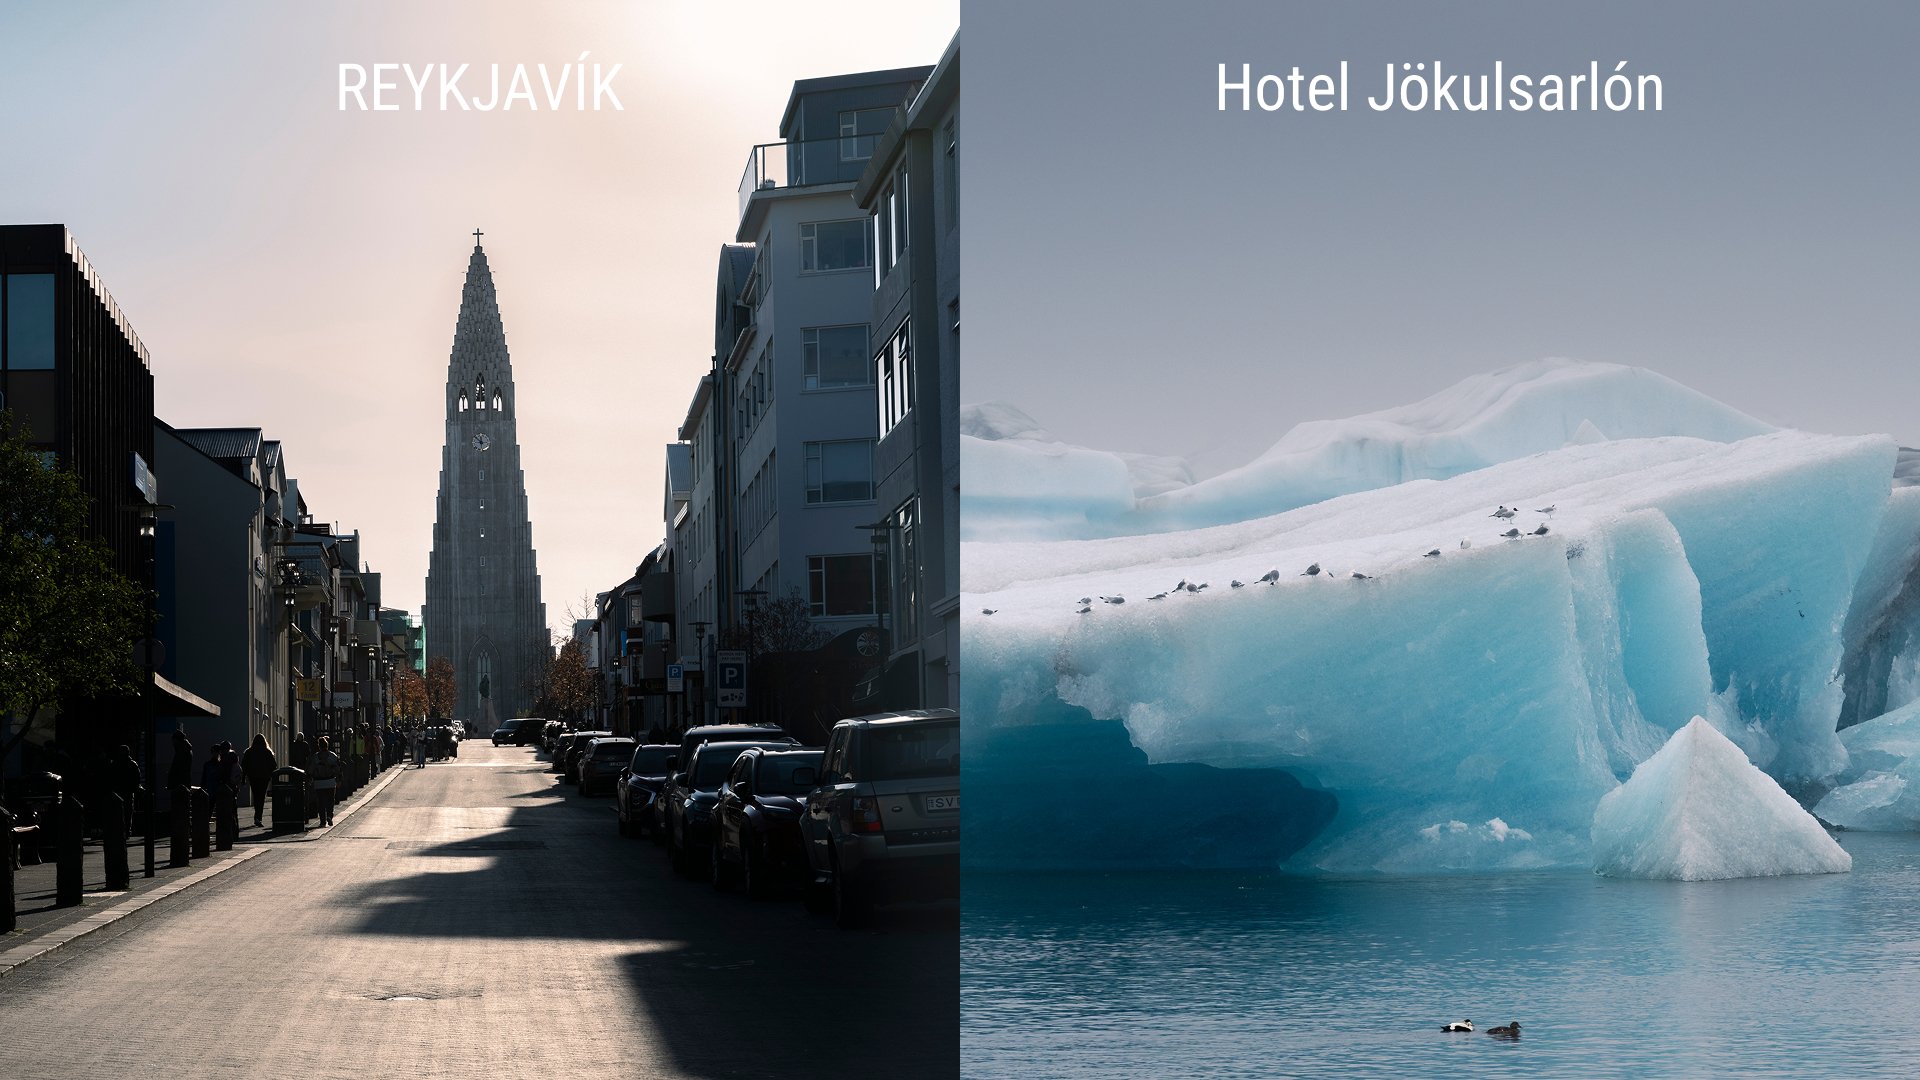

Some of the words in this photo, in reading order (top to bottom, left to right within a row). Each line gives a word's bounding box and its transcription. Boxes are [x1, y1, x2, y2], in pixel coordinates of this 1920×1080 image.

[671, 668, 679, 676] P
[725, 667, 738, 684] P
[303, 681, 315, 692] 12
